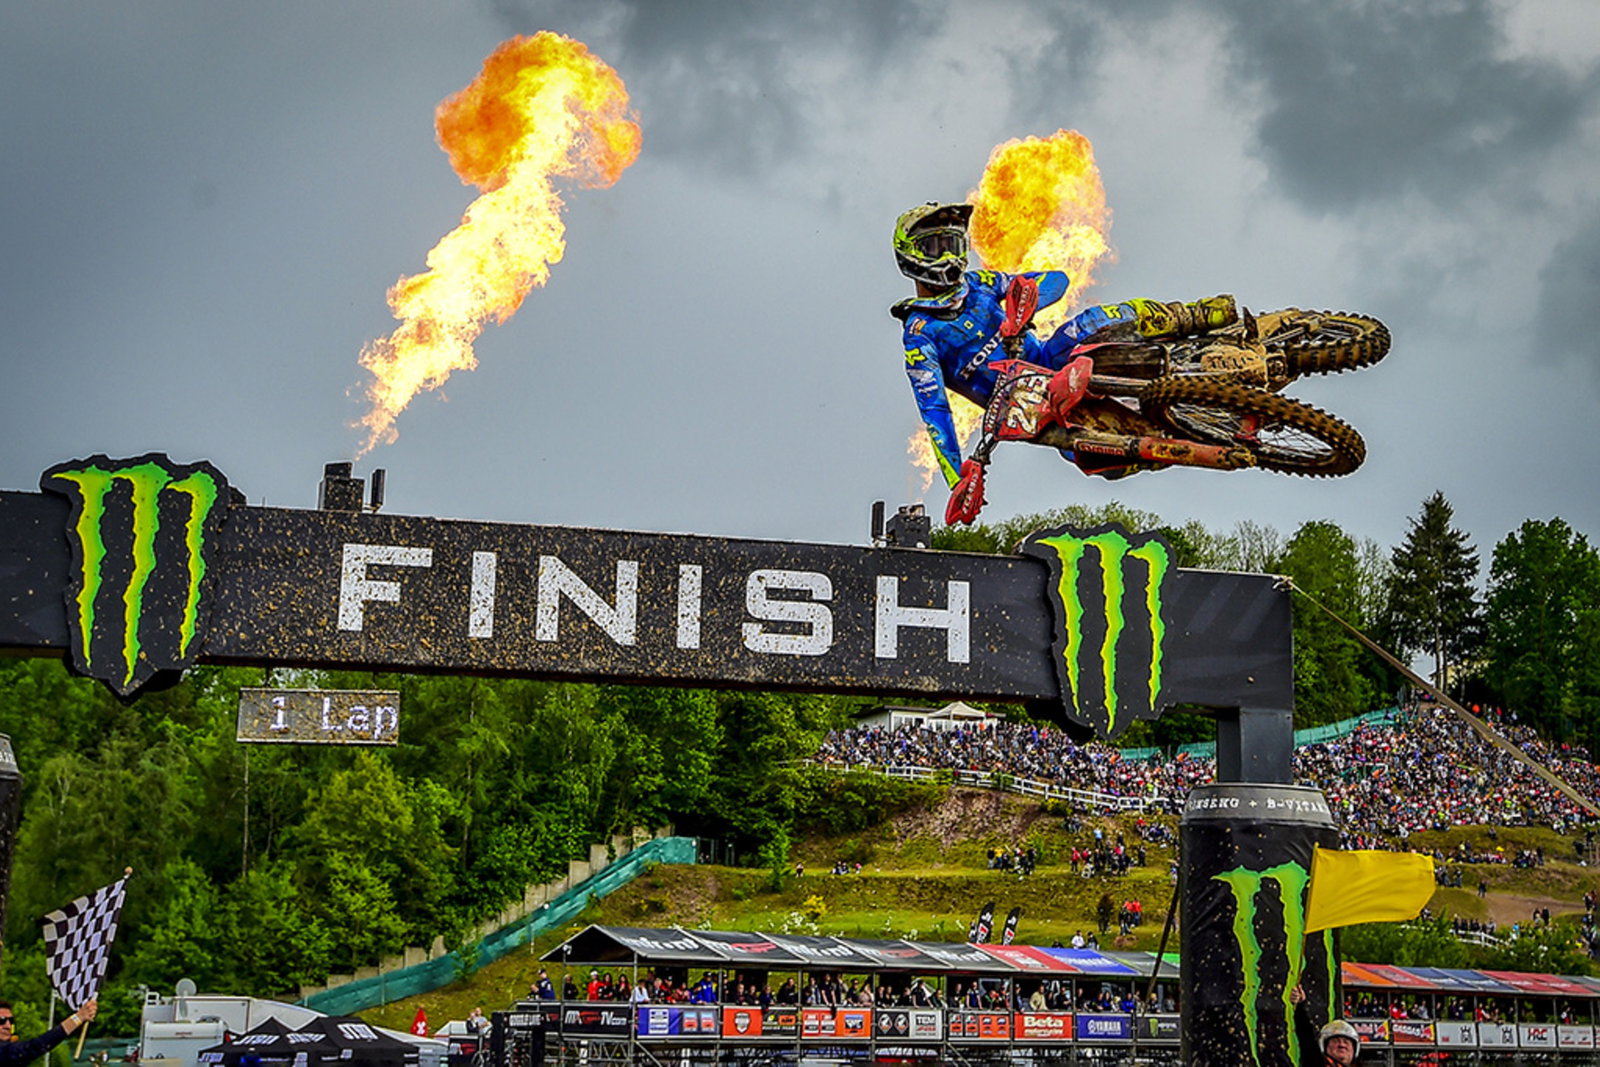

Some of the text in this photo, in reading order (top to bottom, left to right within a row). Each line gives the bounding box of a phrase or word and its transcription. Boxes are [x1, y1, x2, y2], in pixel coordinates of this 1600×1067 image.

[337, 543, 971, 664] FINISH
[270, 696, 398, 740] 1 Lap
[1023, 1016, 1064, 1027] Beta
[1096, 1020, 1121, 1032] YAMAHA
